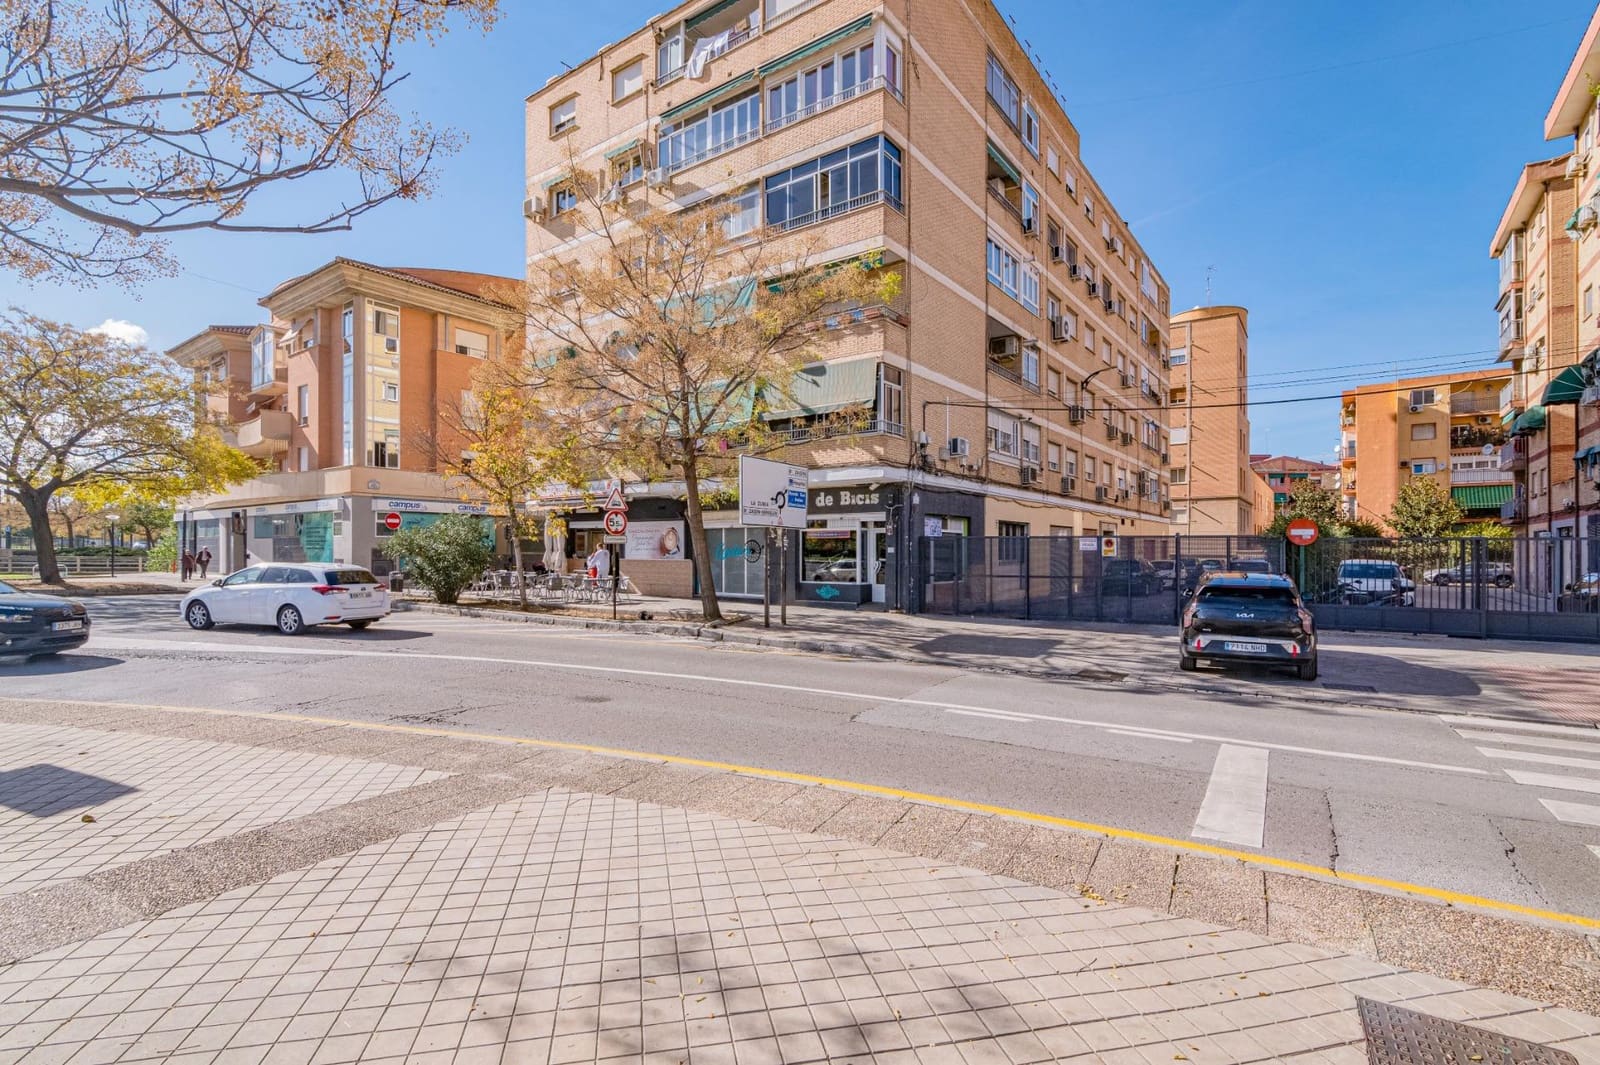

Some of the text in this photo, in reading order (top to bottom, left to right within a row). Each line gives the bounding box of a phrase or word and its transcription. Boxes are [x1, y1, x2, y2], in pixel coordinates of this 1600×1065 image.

[815, 492, 833, 507] de
[840, 490, 880, 505] Bicis
[388, 500, 420, 510] campus
[458, 503, 486, 513] campus
